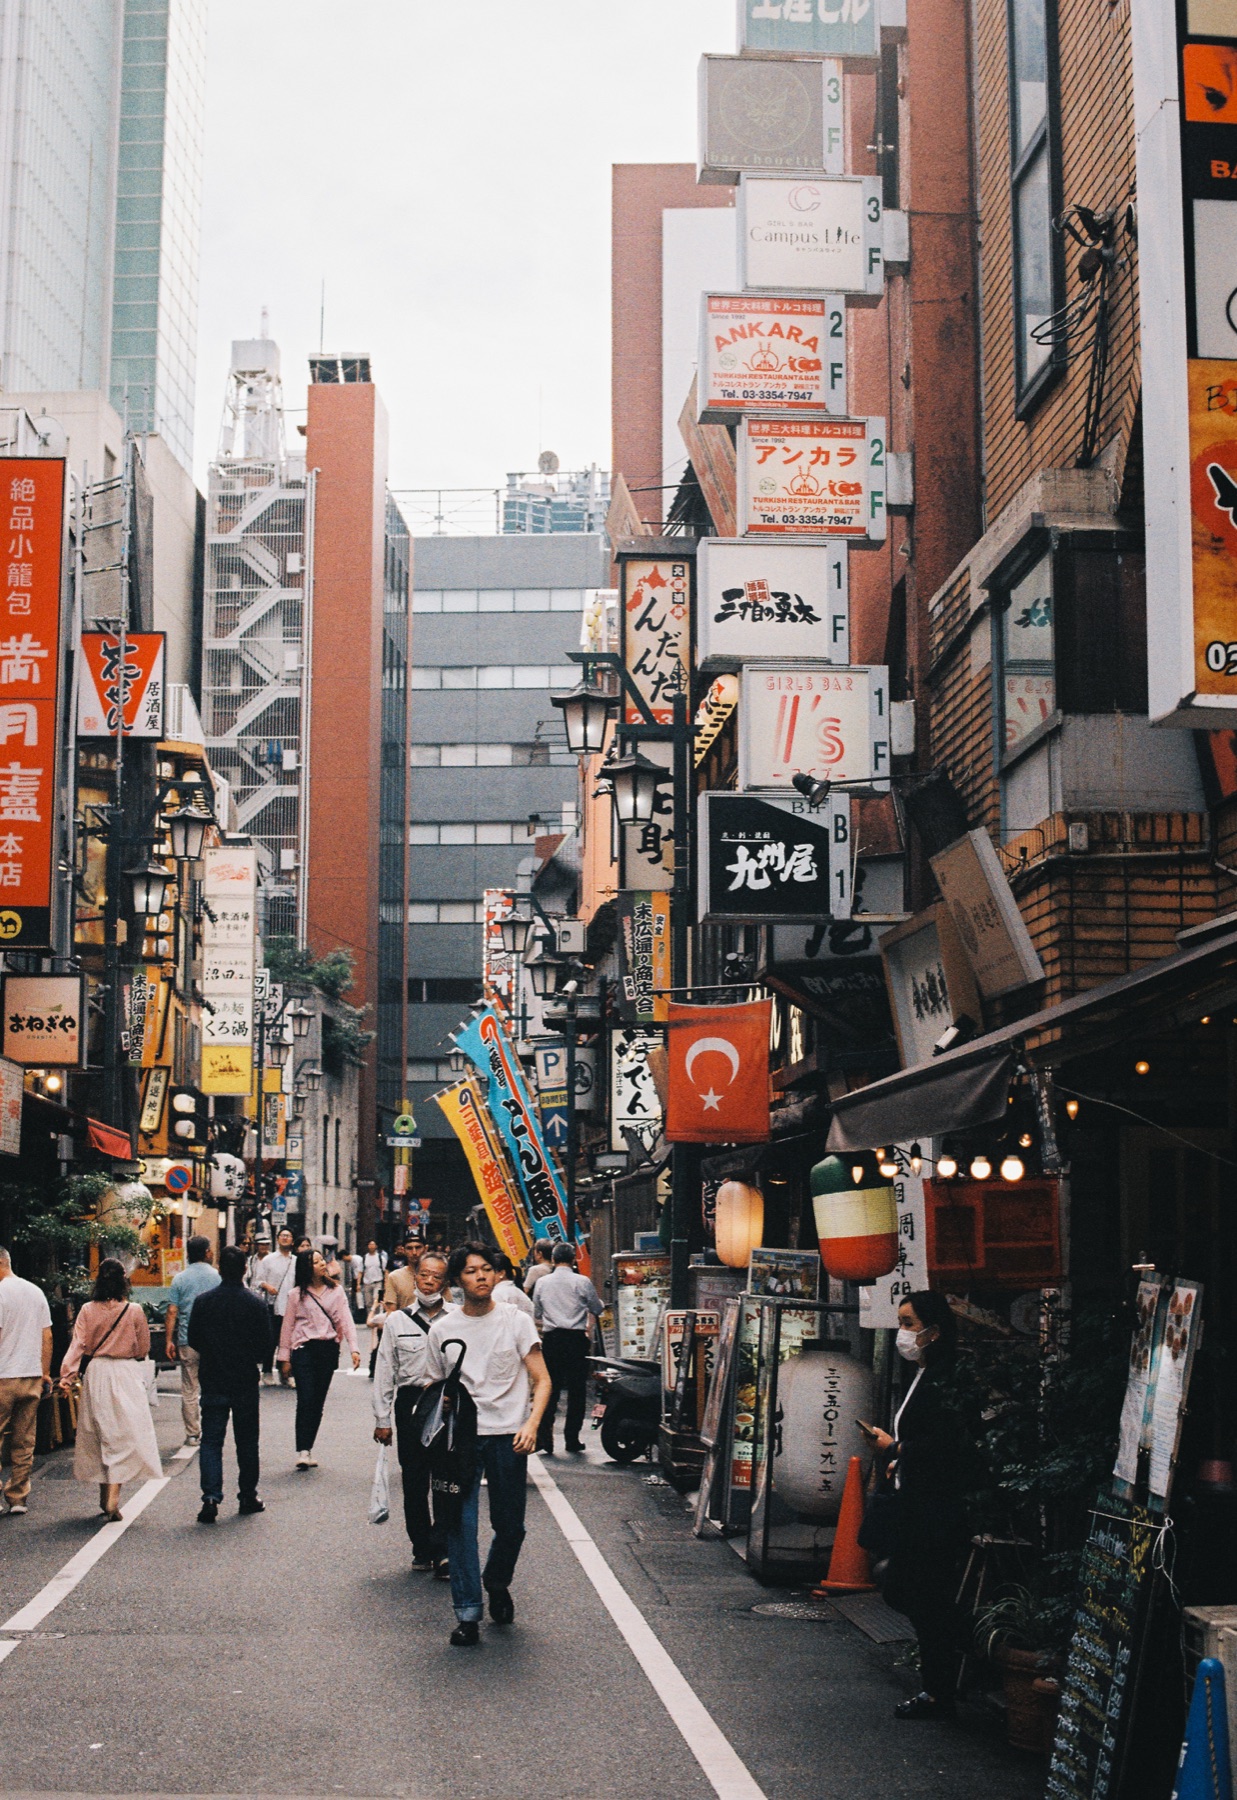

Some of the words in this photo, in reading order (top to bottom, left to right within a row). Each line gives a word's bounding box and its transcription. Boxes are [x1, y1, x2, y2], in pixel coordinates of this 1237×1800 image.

[1210, 160, 1237, 179] B
[750, 227, 819, 246] Campus
[867, 197, 881, 274] 3F
[714, 322, 819, 353] ANKARA
[830, 311, 843, 389] 2F
[721, 389, 739, 399] Tel.
[742, 390, 813, 400] 03-3354-7947
[1206, 385, 1237, 412] B
[755, 445, 858, 467] アンカラ
[870, 439, 884, 518] 2F
[761, 514, 779, 523] Tel.
[782, 515, 853, 525] 03-3354-7947
[6, 477, 36, 616] 絶品小籠包
[832, 561, 846, 643] 1F
[632, 596, 682, 704] んだんだ
[822, 678, 853, 691] BAR
[145, 681, 160, 730] 居酒屋
[874, 688, 887, 771] 1F
[725, 842, 818, 892] 九州屋
[833, 814, 847, 898] B1
[9, 1013, 76, 1033] おねぎや
[543, 1052, 560, 1077] P
[290, 1140, 299, 1153] P
[744, 1308, 816, 1327] AARA
